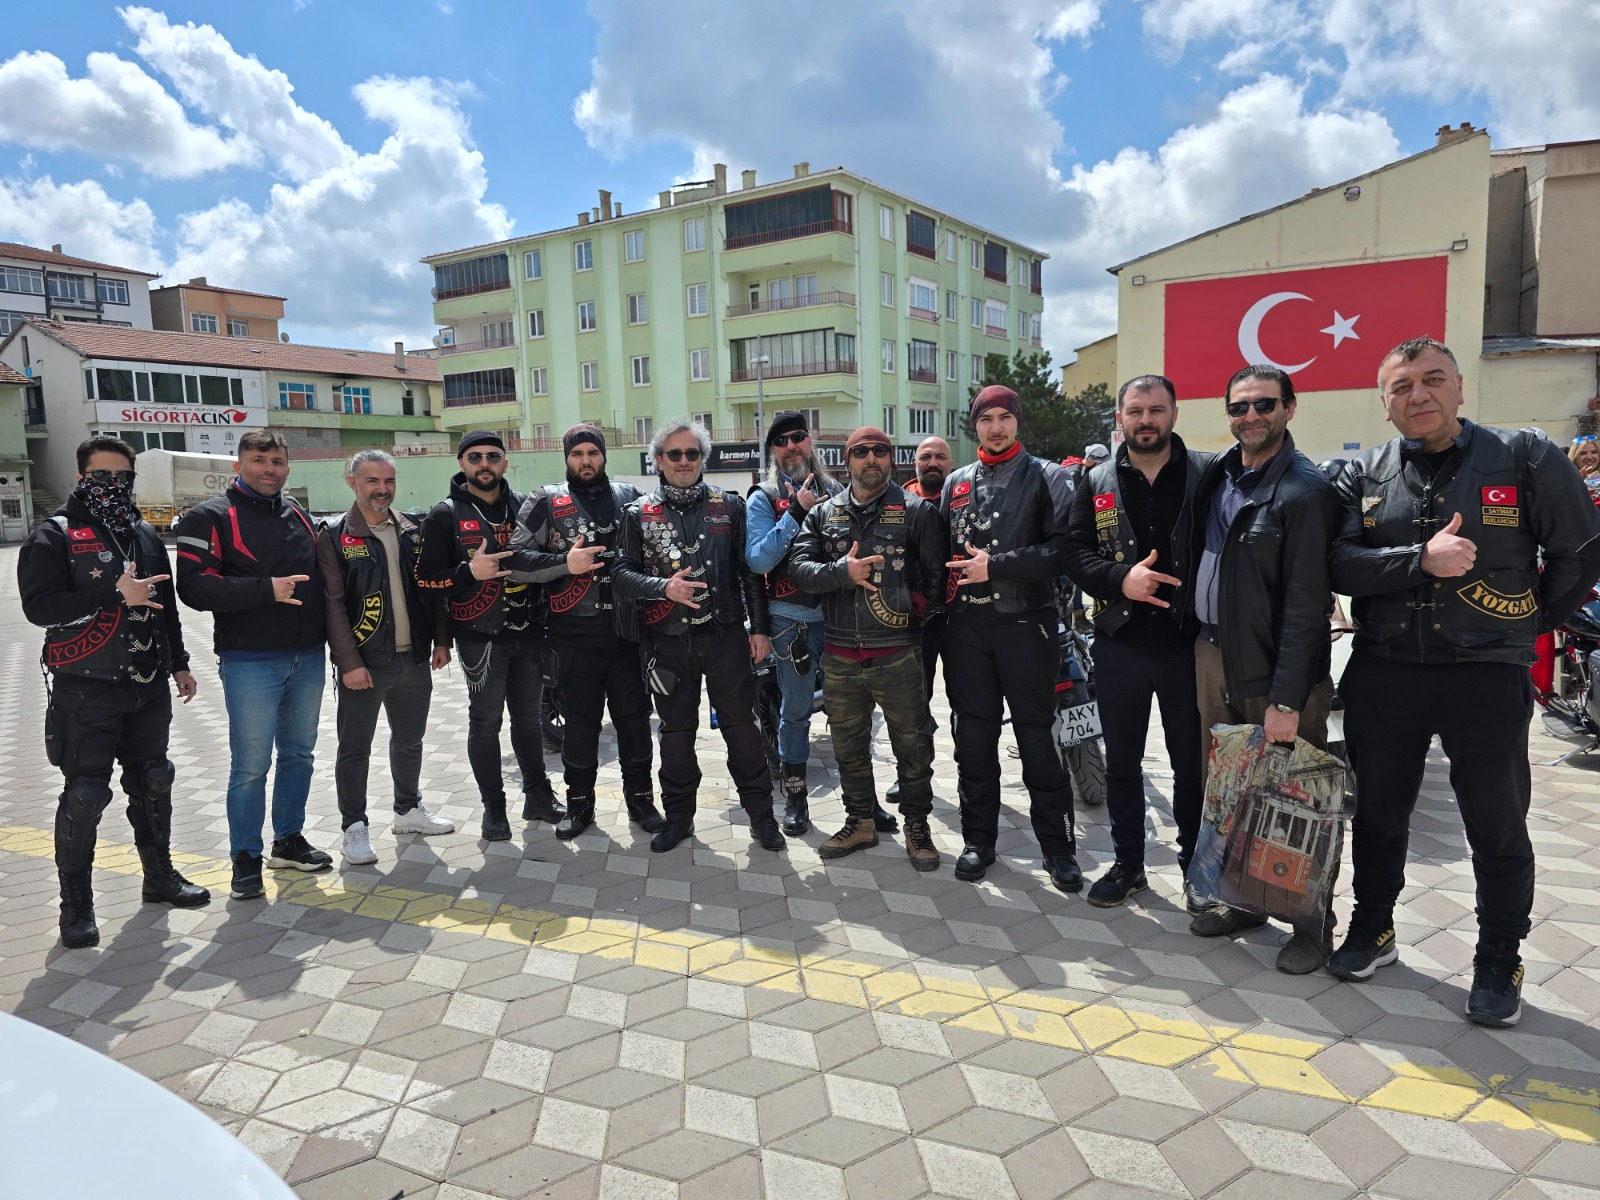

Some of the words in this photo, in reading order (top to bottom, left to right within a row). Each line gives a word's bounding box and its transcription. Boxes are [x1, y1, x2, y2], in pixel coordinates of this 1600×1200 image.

[719, 450, 750, 459] karmen
[751, 449, 760, 459] ha
[817, 447, 845, 466] RTL
[452, 583, 497, 618] YOZGAT
[552, 577, 589, 610] YOZGA
[869, 591, 906, 625] YOZGAT
[1471, 584, 1534, 615] YOZGAT
[354, 595, 381, 642] İVAS
[52, 610, 117, 661] YOZGAT
[1069, 704, 1095, 722] AKY
[1067, 722, 1094, 739] 704
